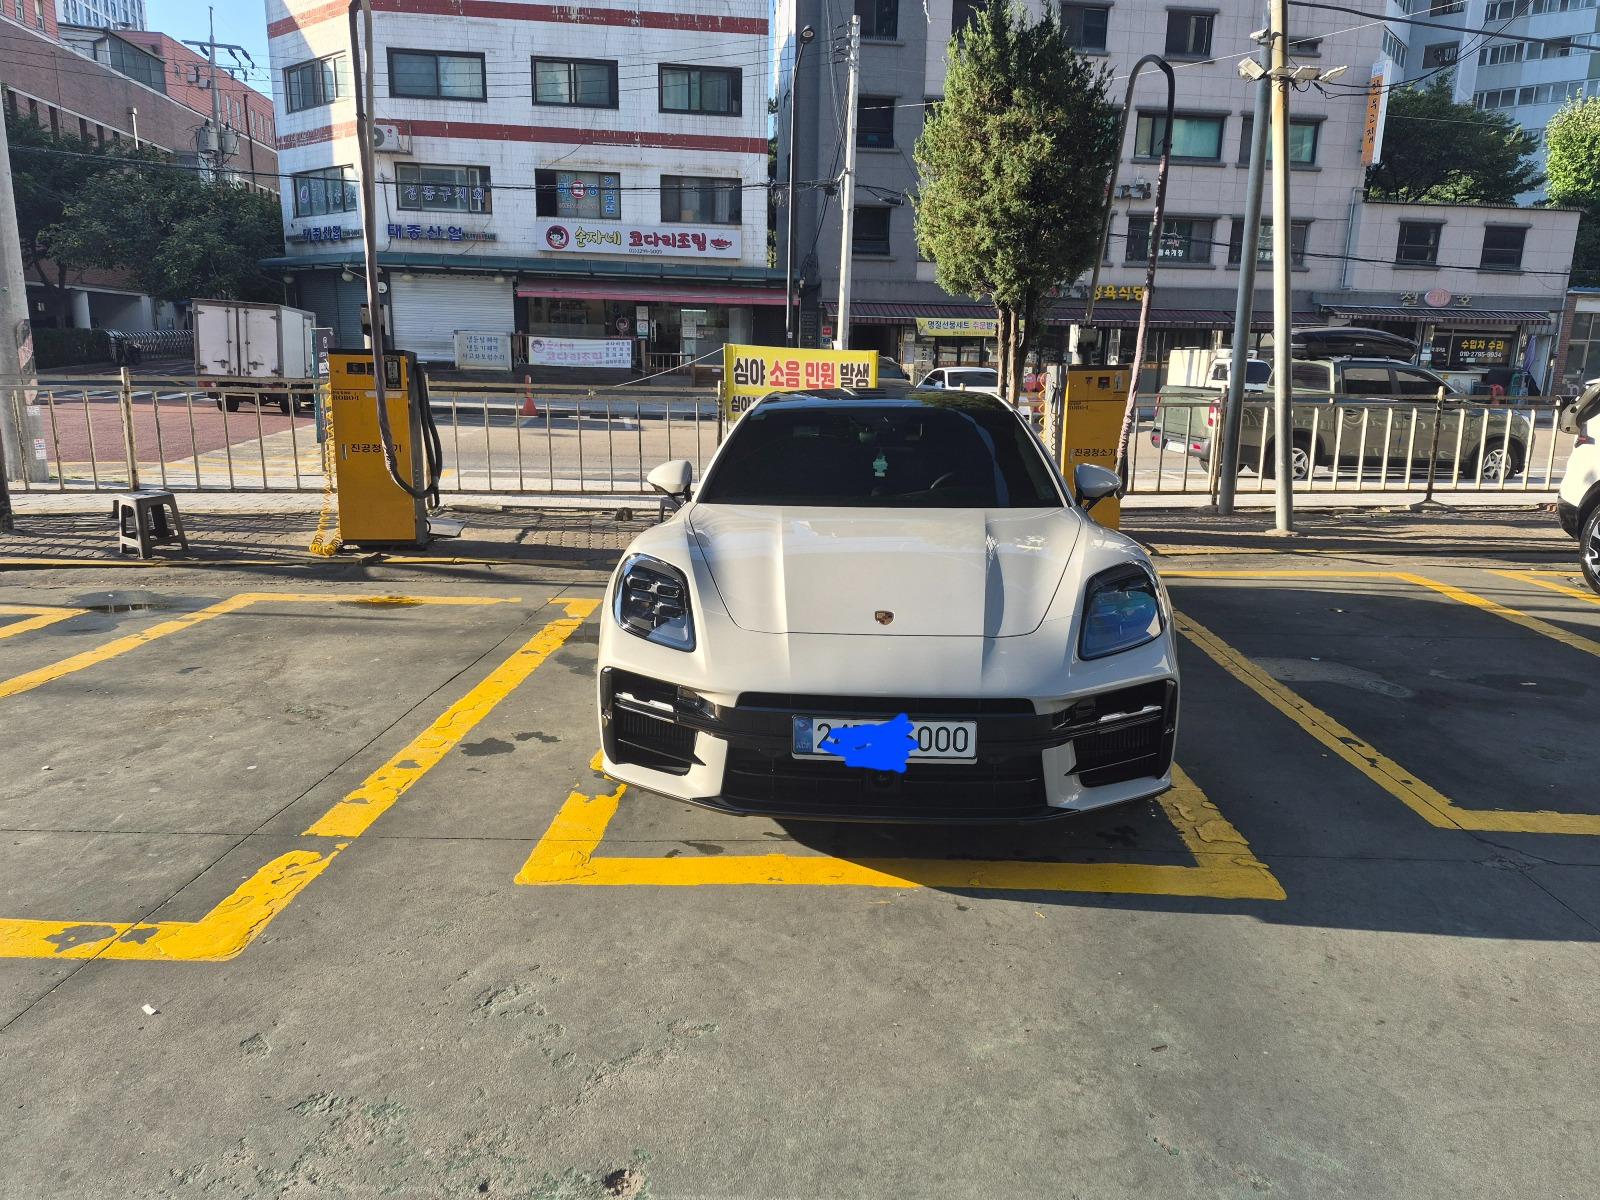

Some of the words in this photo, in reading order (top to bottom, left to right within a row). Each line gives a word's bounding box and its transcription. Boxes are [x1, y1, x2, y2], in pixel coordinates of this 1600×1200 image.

[388, 224, 464, 243] 태종산업
[575, 226, 622, 247] 순자네
[629, 231, 706, 251] 코다리조림
[1461, 340, 1485, 350] 수입차
[1488, 340, 1504, 350] 수리
[734, 358, 765, 386] 심야
[770, 360, 800, 387] 소음
[805, 362, 835, 388] 민원
[840, 363, 870, 387] 발생
[351, 443, 402, 453] 진공청기
[1075, 448, 1116, 457] 진공청소기
